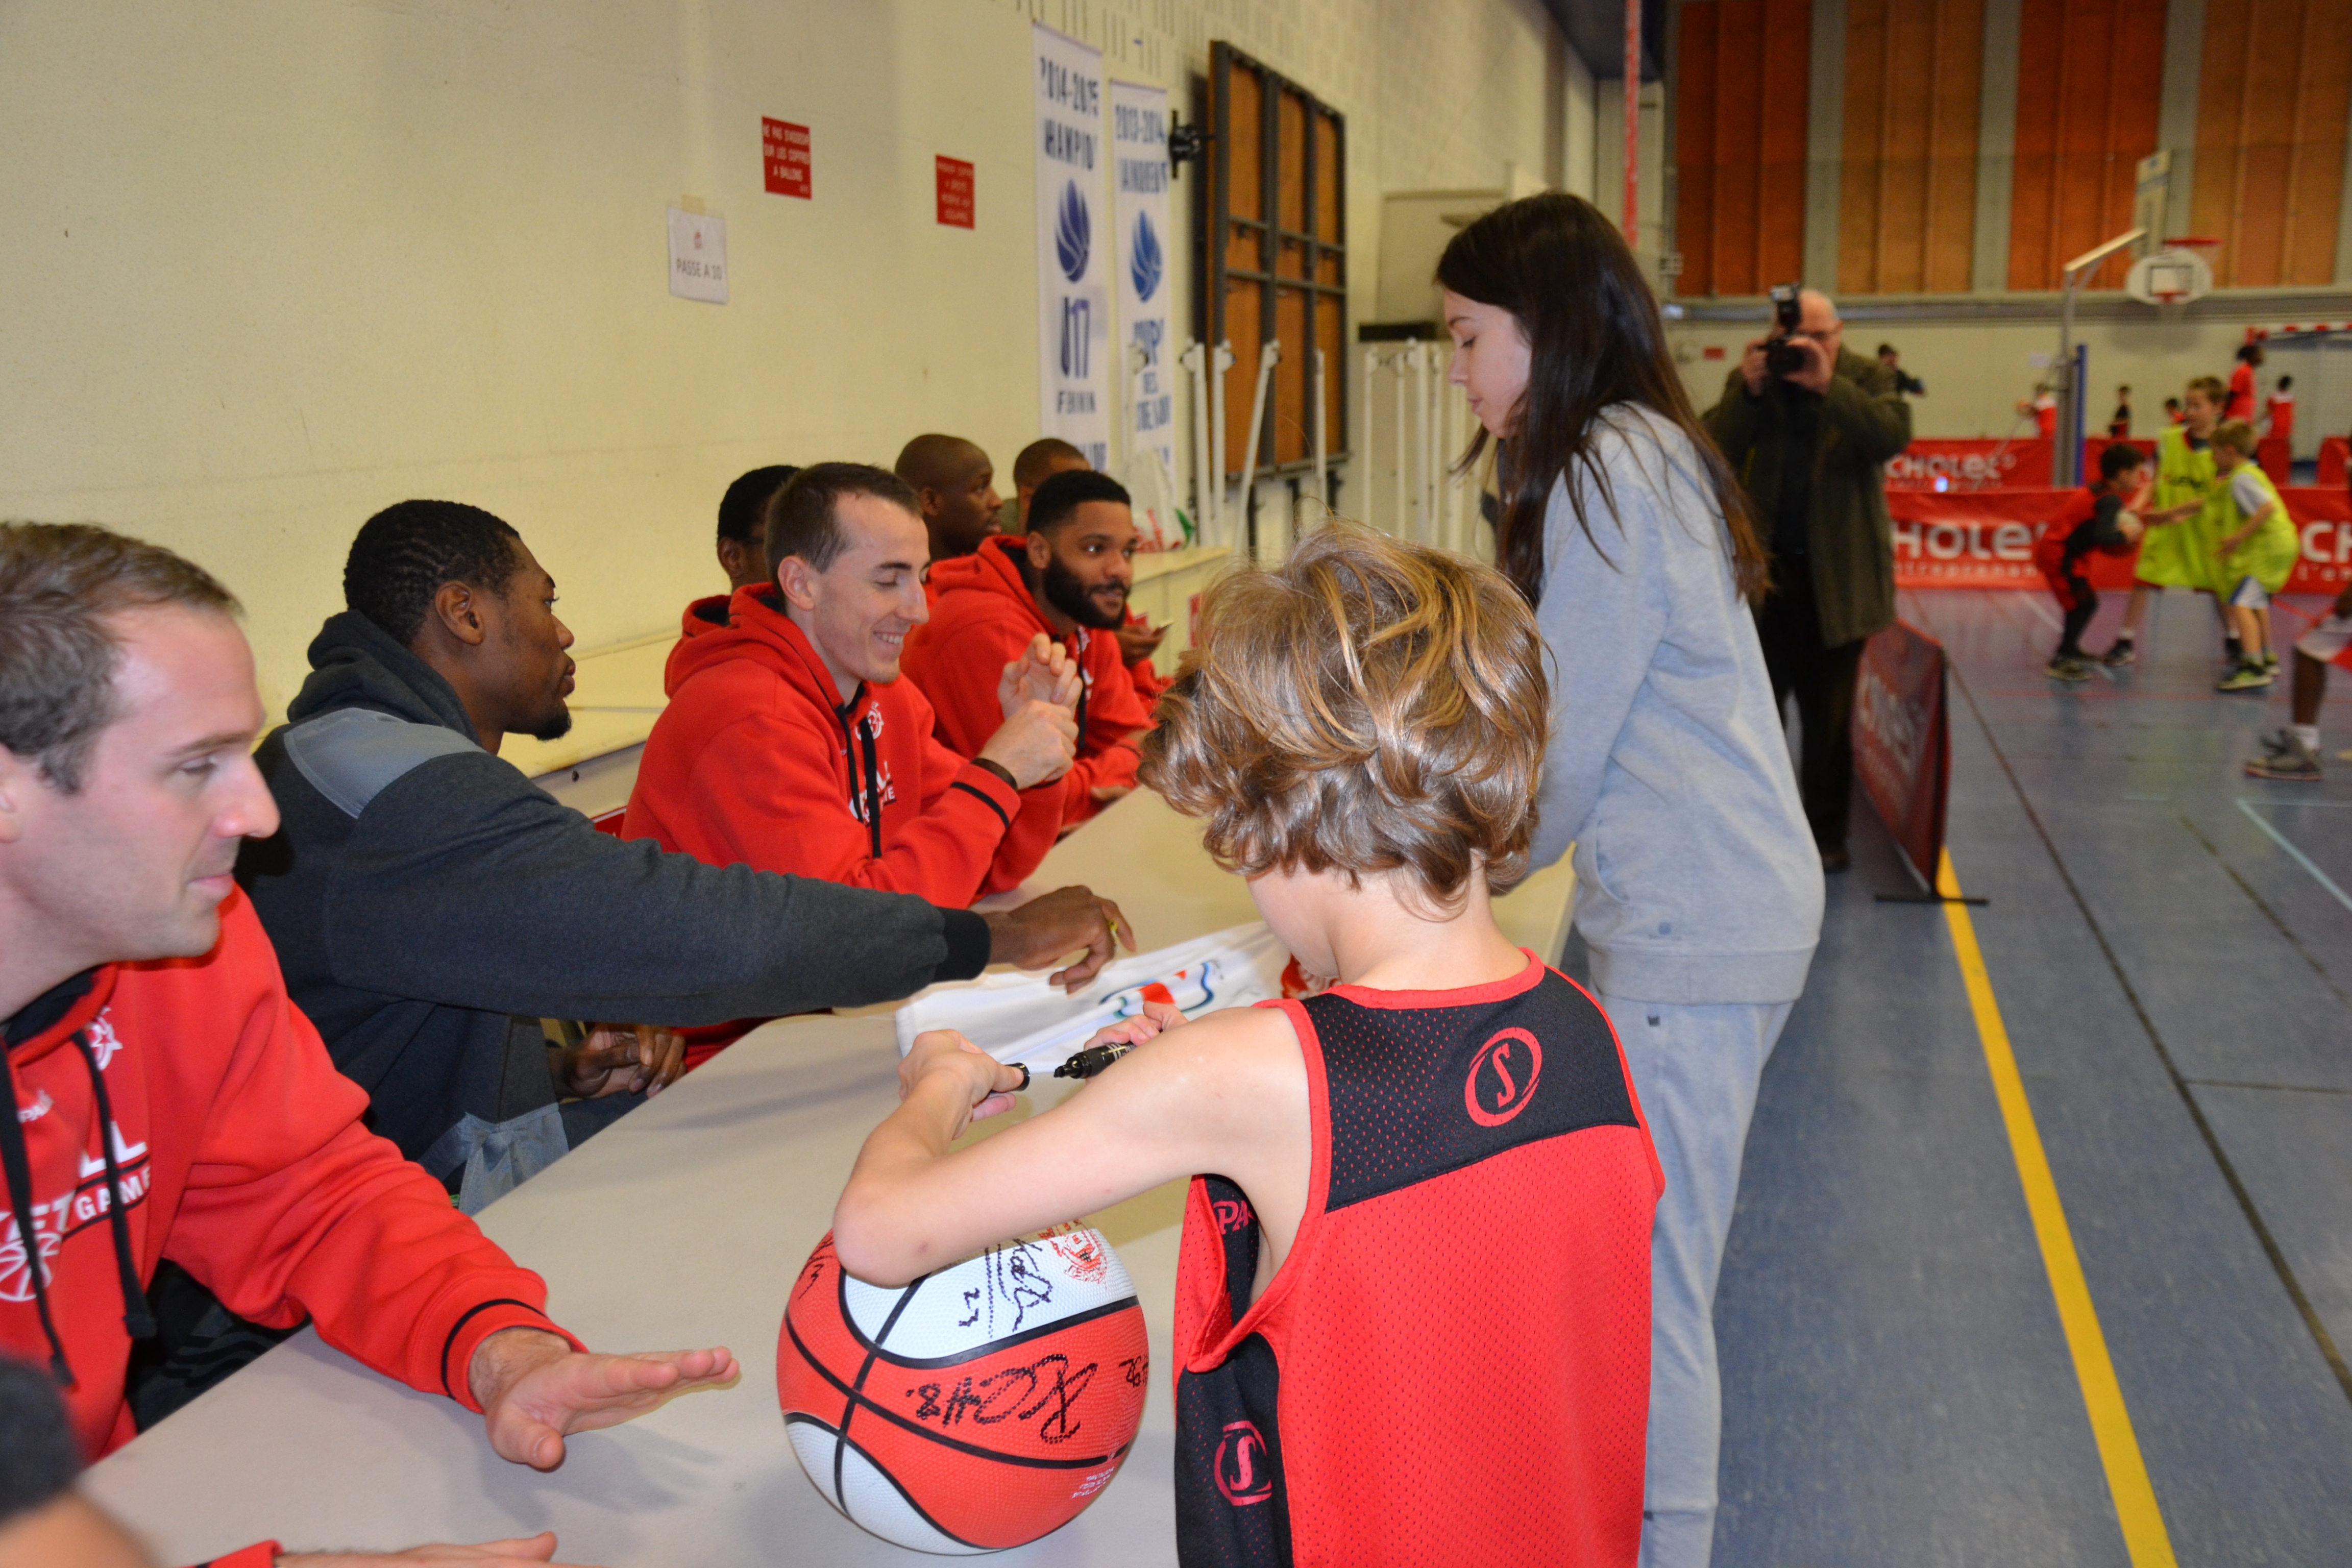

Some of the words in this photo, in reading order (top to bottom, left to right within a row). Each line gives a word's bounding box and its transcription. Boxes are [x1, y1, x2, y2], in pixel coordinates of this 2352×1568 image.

[676, 258, 701, 278] PASSE
[703, 263, 710, 278] A
[712, 264, 723, 280] 10
